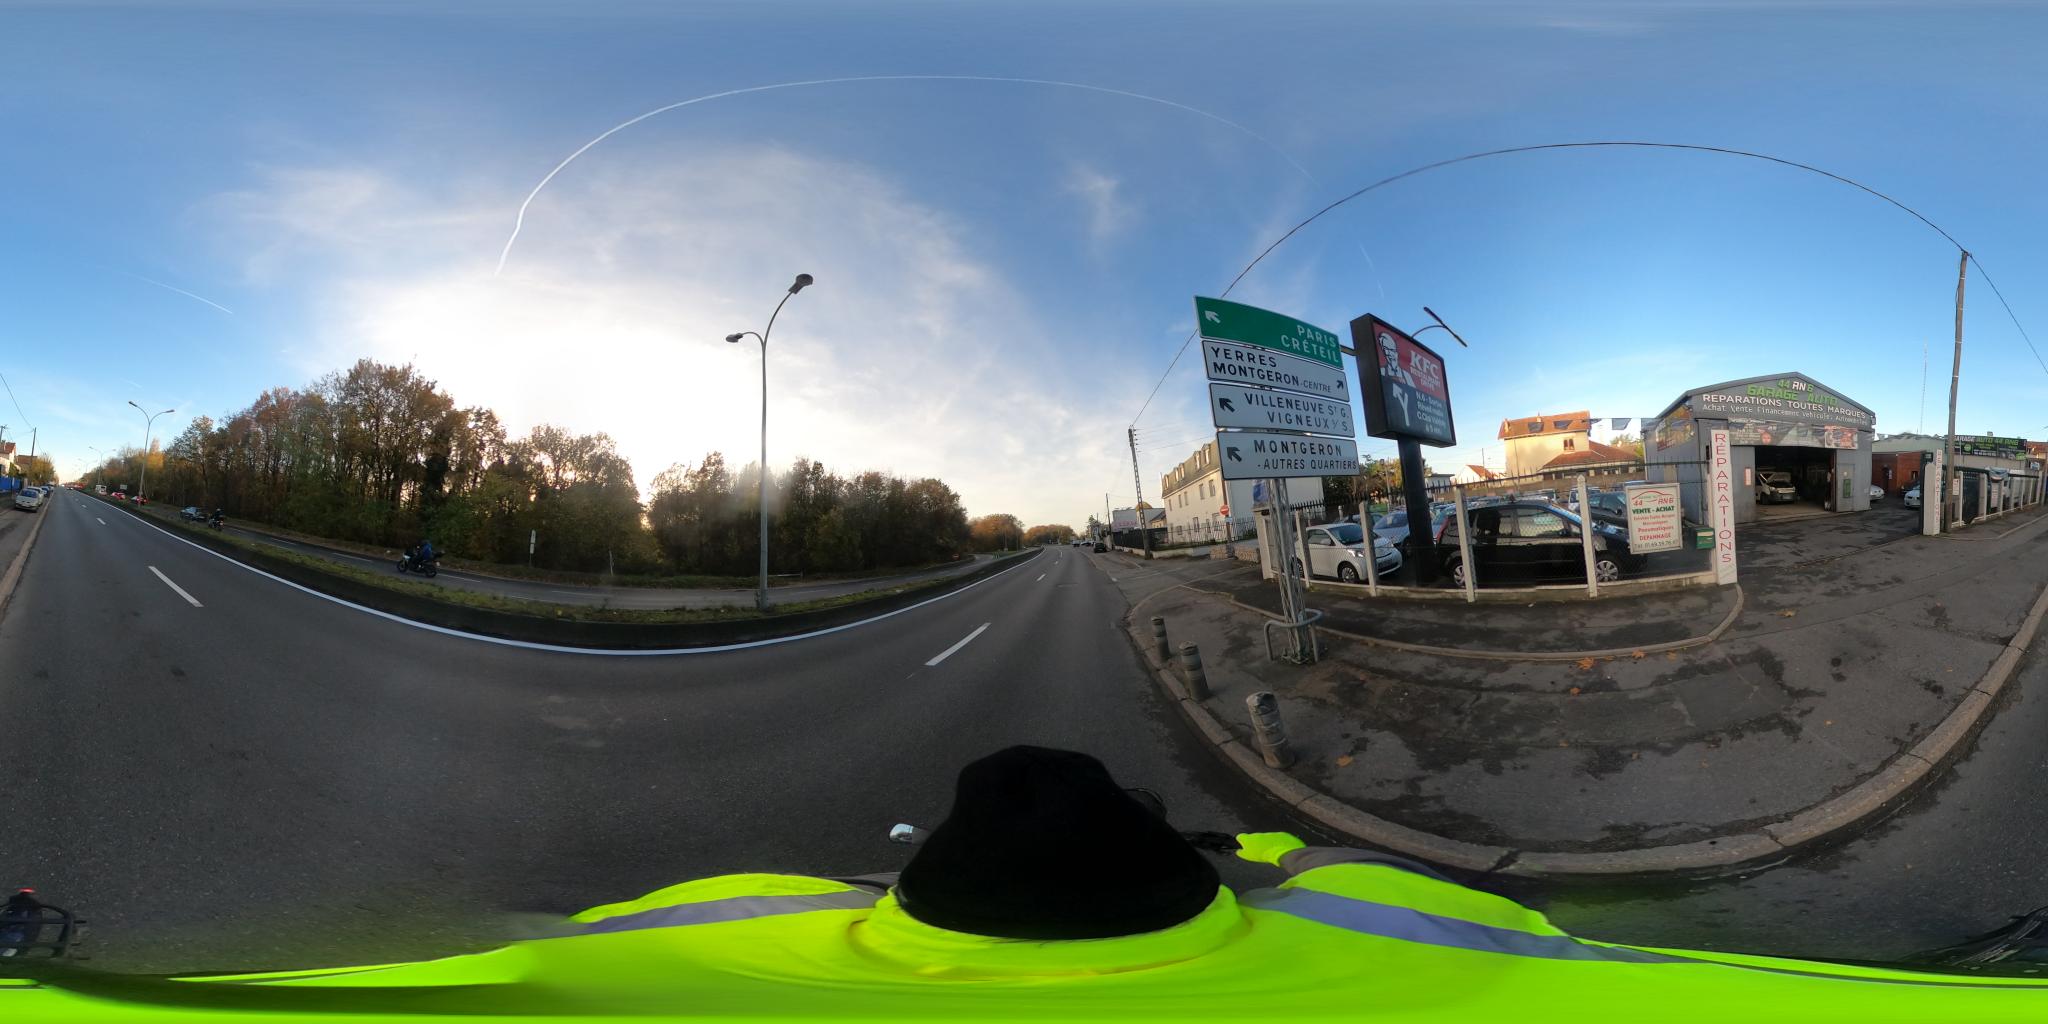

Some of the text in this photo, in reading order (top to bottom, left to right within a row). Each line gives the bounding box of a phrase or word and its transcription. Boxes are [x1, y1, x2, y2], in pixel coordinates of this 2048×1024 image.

[1297, 324, 1337, 347] PARIS
[1211, 346, 1277, 368] YERRES
[1280, 334, 1340, 363] CRÉTEIL
[1409, 350, 1439, 379] KFC
[1747, 383, 1838, 405] GARAGE AUTO
[1778, 379, 1791, 389] 44
[1244, 392, 1328, 414] VILLENEUVE
[1702, 394, 1866, 419] REPARATIONS TOUTES MARQUES
[1702, 404, 1727, 412] Achat
[1730, 404, 1753, 414] Vente
[1267, 411, 1330, 430] VIGNEUX
[1254, 439, 1342, 457] MONTGERON
[1310, 460, 1357, 470] QUARTIERS
[1632, 507, 1651, 515] VENTE
[1655, 505, 1675, 513] ACHAT
